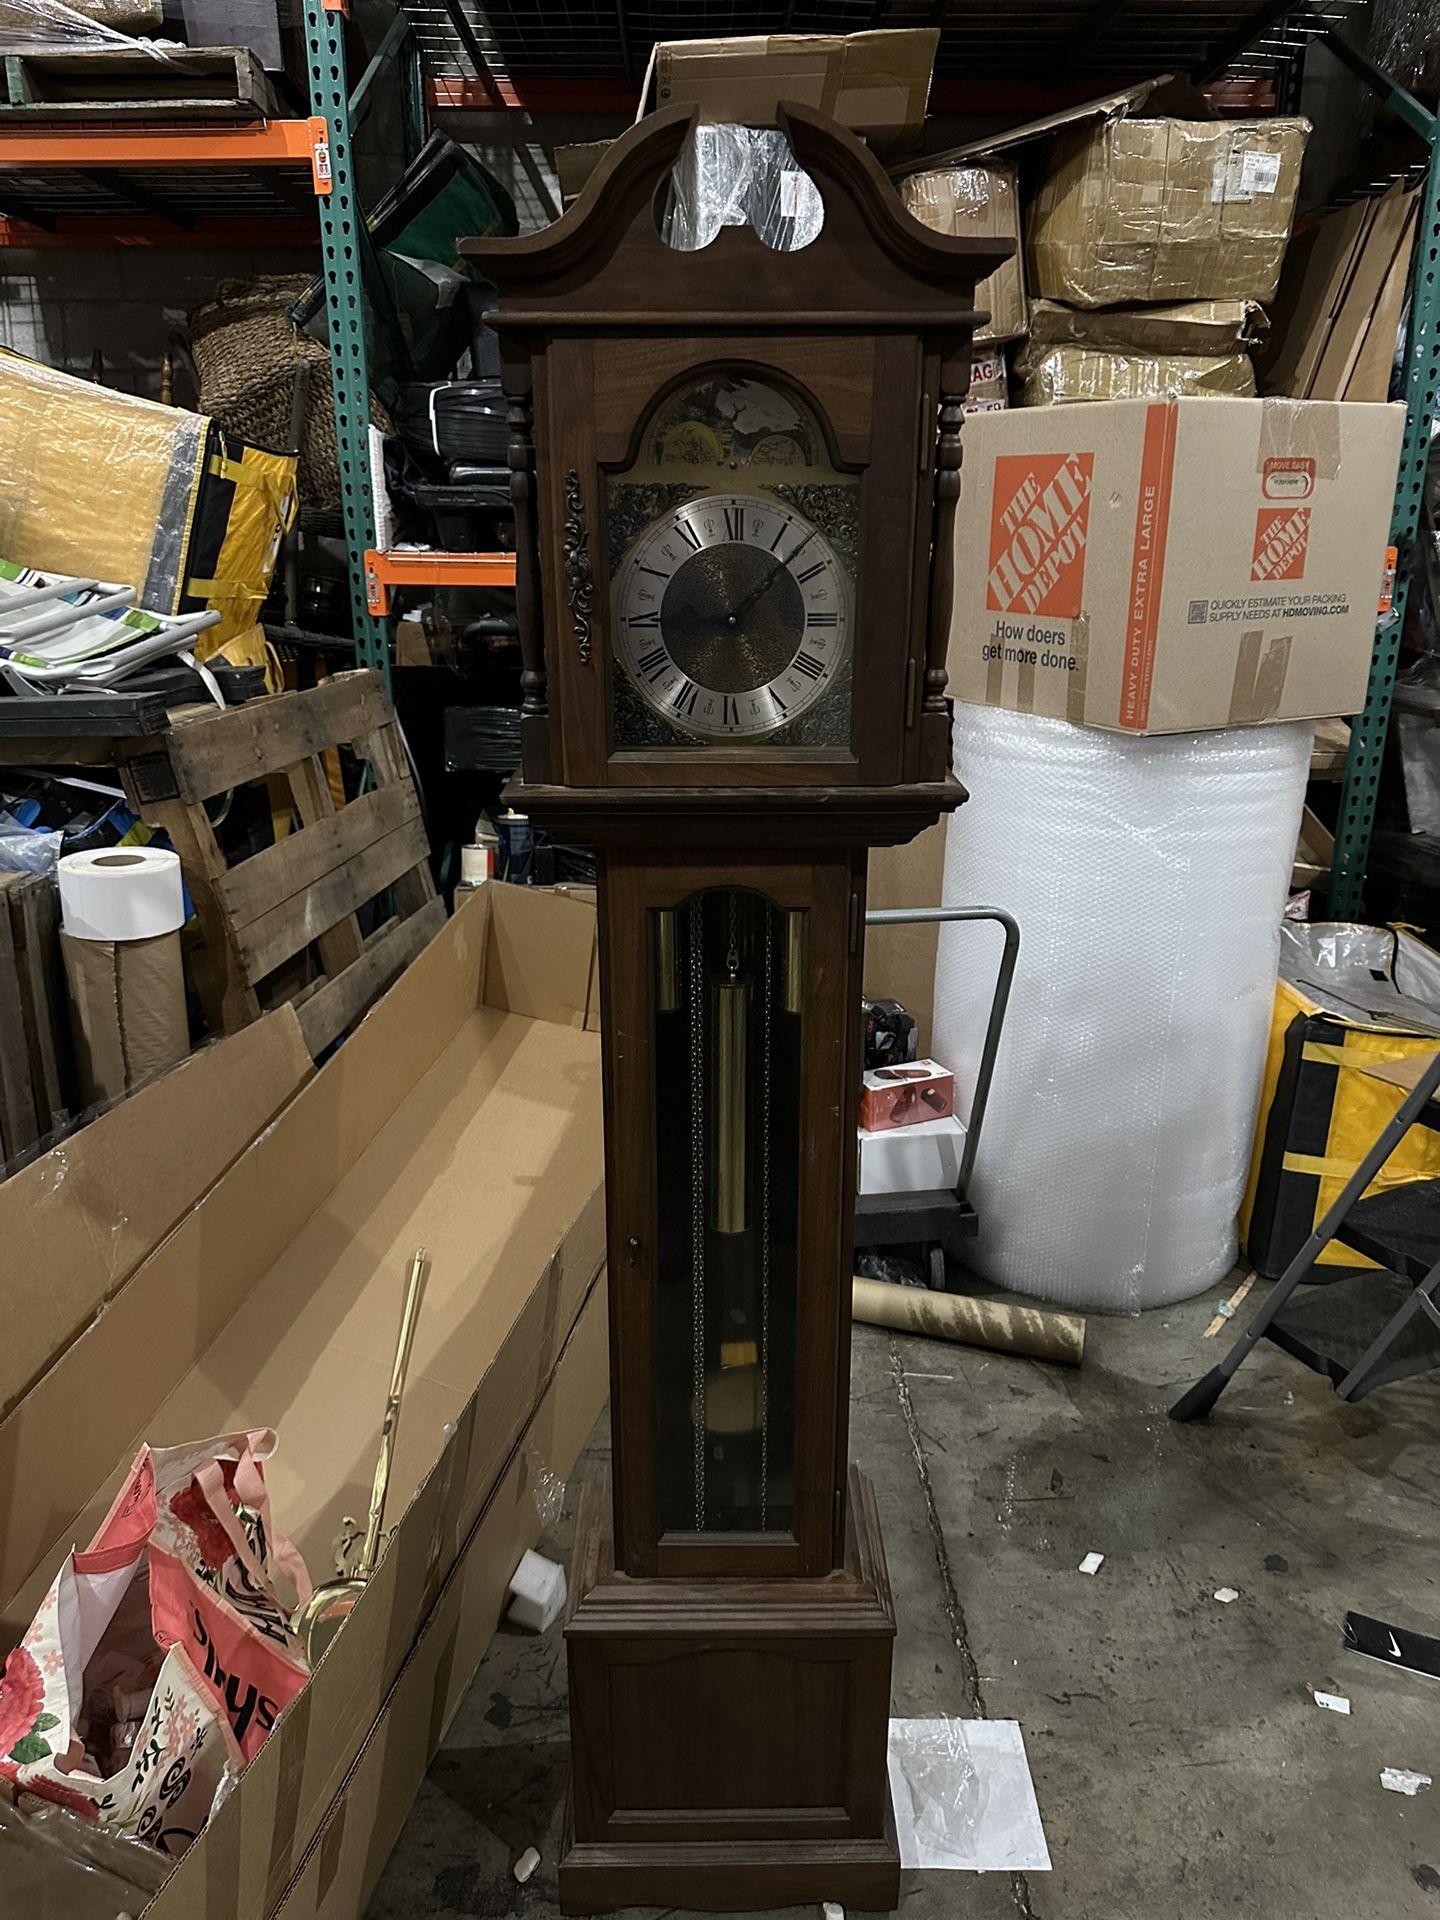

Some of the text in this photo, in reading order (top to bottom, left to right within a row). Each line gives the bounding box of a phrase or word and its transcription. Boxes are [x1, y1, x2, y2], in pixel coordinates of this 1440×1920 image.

[1000, 471, 1041, 535] THE
[988, 453, 1093, 611] HOME
[1252, 508, 1311, 580] HOME
[1261, 515, 1285, 544] THE
[1022, 515, 1088, 615] DEPOT
[1272, 534, 1308, 579] DEPOT
[1126, 485, 1155, 720] HEAVY DUTY EXTRA LARGE
[1209, 604, 1349, 622] SUPPLY NEEDS AT HDMOVING.COM
[1210, 593, 1346, 610] QUICKLY ESTIMATE YOUR PACKING
[995, 620, 1066, 646] How doers
[982, 643, 1079, 671] get more done.
